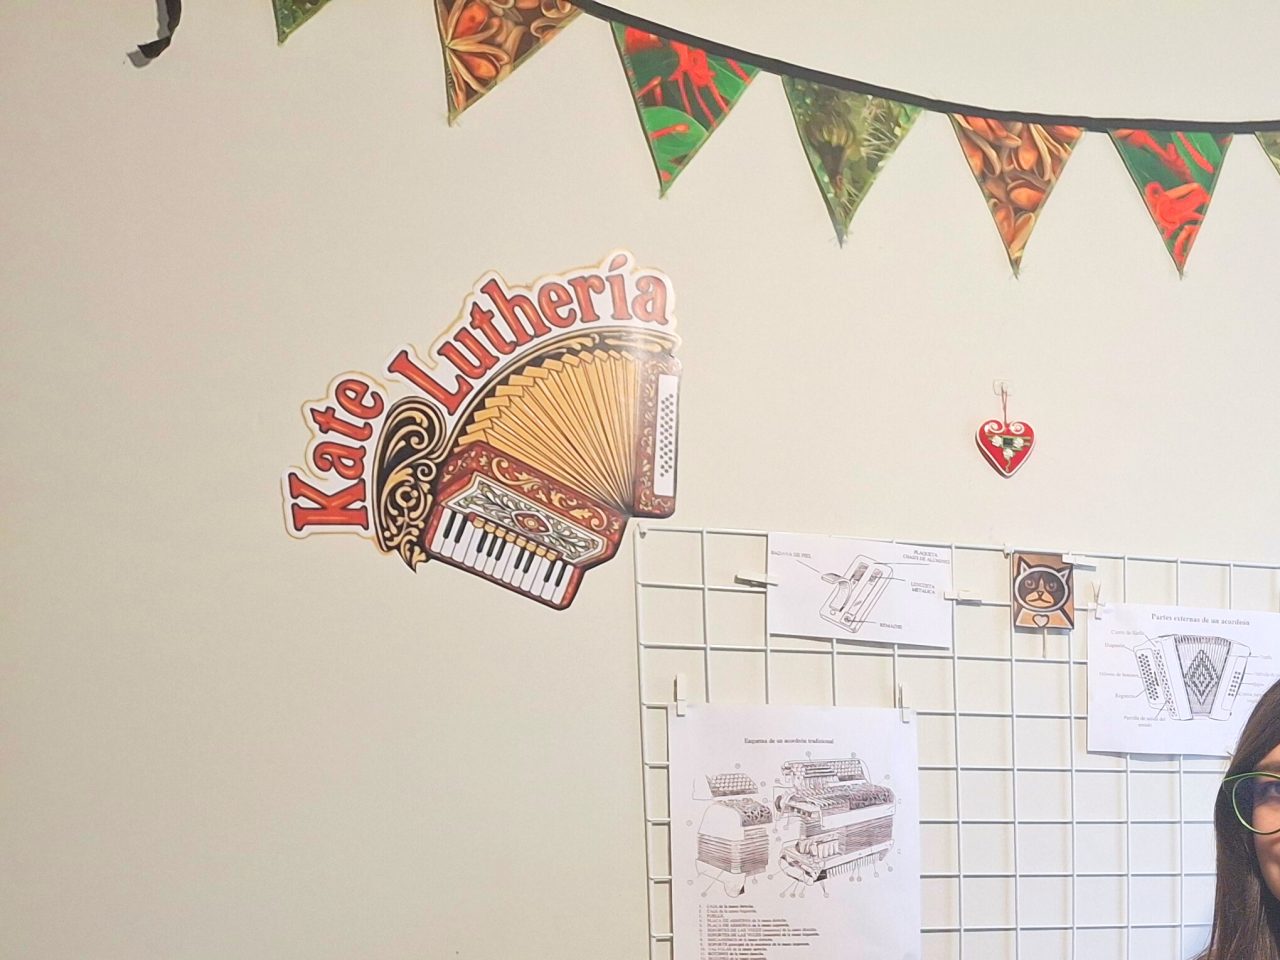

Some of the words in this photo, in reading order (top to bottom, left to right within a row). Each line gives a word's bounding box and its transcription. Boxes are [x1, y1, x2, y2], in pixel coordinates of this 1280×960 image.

[289, 377, 385, 532] Kate
[387, 253, 669, 417] Luthería
[1202, 616, 1210, 624] de
